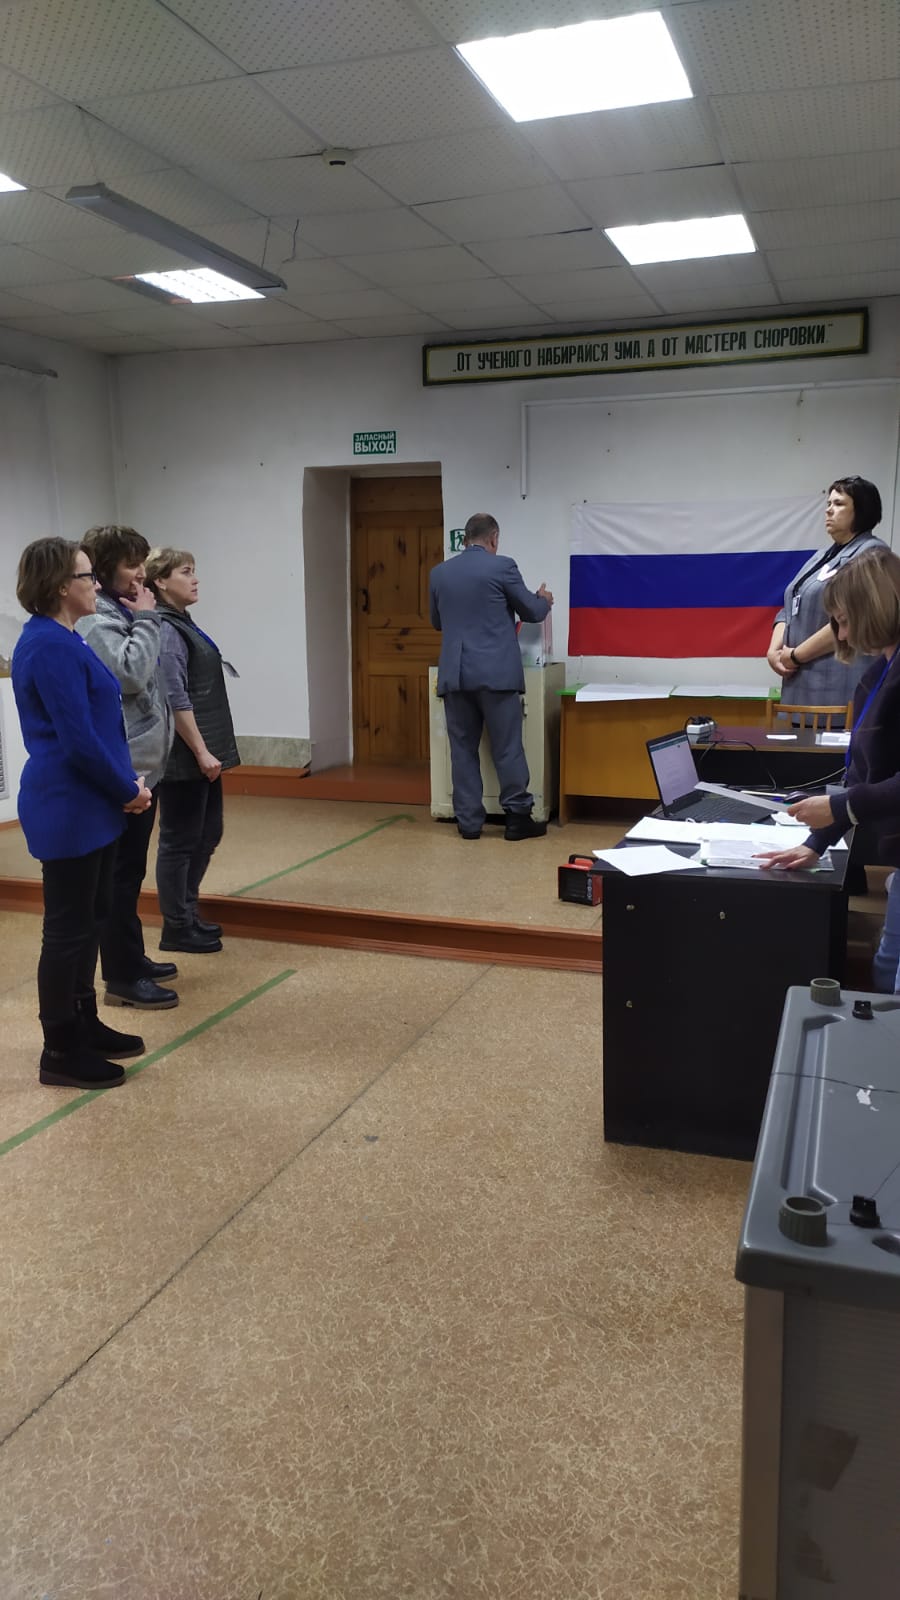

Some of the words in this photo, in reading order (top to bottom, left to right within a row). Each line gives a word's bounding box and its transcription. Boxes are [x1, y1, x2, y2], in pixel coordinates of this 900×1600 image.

[478, 349, 531, 370] УЧЕНОГО
[537, 342, 608, 366] НАБИРАЙСЯ
[647, 339, 655, 358] А
[662, 336, 679, 356] ОТ
[685, 330, 747, 355] МАСТЕРА
[355, 431, 395, 442] ЗАПАСНЫЙ
[354, 440, 395, 454] ВЫХОД
